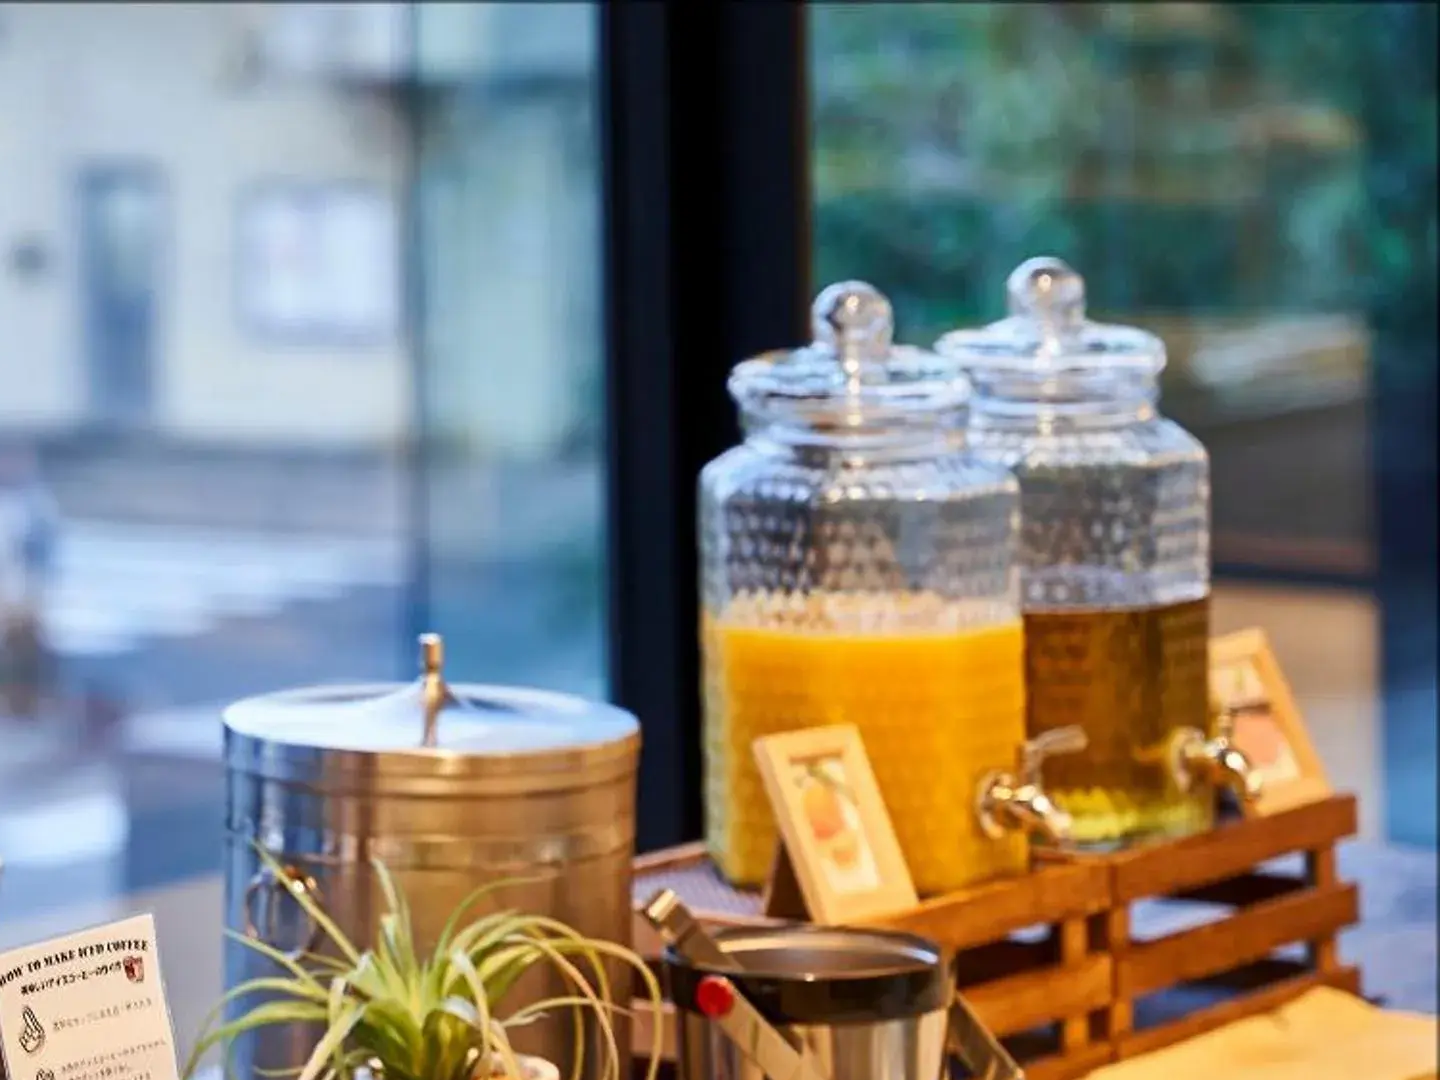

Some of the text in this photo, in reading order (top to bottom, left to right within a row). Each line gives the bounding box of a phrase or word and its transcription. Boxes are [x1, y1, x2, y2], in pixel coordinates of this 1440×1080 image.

[27, 957, 42, 973] TO
[43, 949, 76, 967] MAKE
[106, 938, 149, 952] COFFEE
